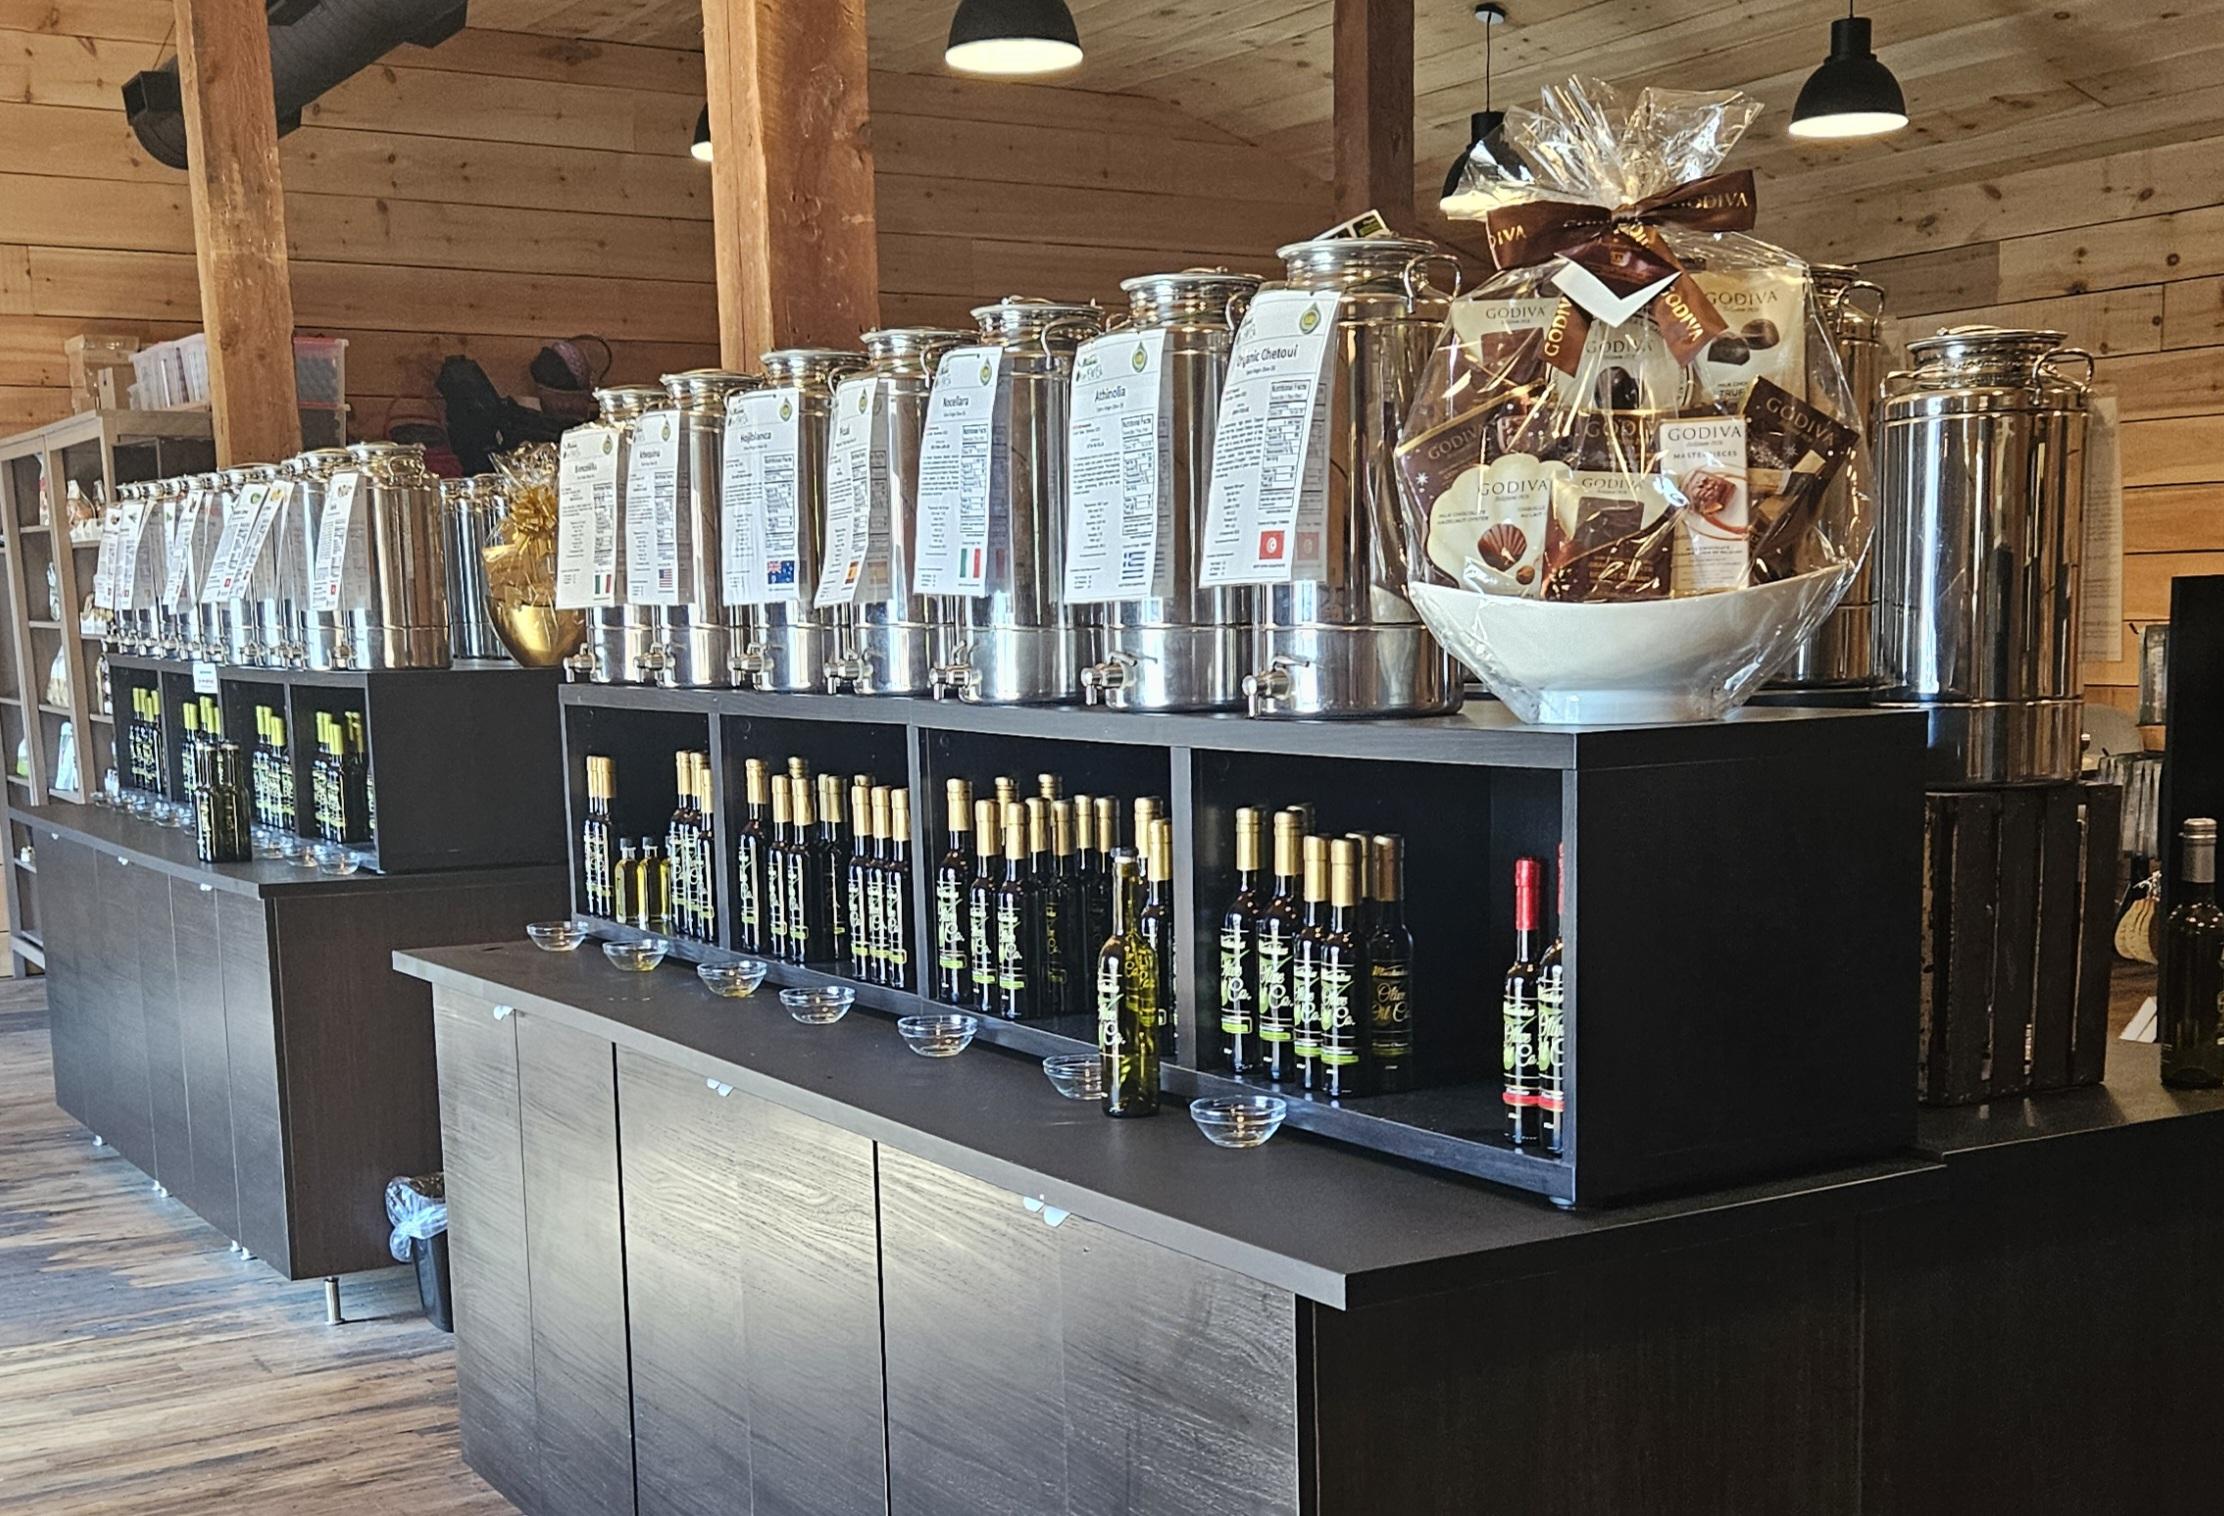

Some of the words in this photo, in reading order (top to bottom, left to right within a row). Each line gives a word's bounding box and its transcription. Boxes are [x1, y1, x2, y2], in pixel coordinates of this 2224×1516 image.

[1707, 291, 1778, 304] GODIVA
[1485, 306, 1546, 320] GODIVA
[1661, 287, 1704, 342] ODIVA
[1261, 344, 1299, 360] Chetoui
[1765, 397, 1834, 447] GODIVA
[1667, 426, 1743, 442] GODIVA
[1478, 479, 1548, 496] GODIVA
